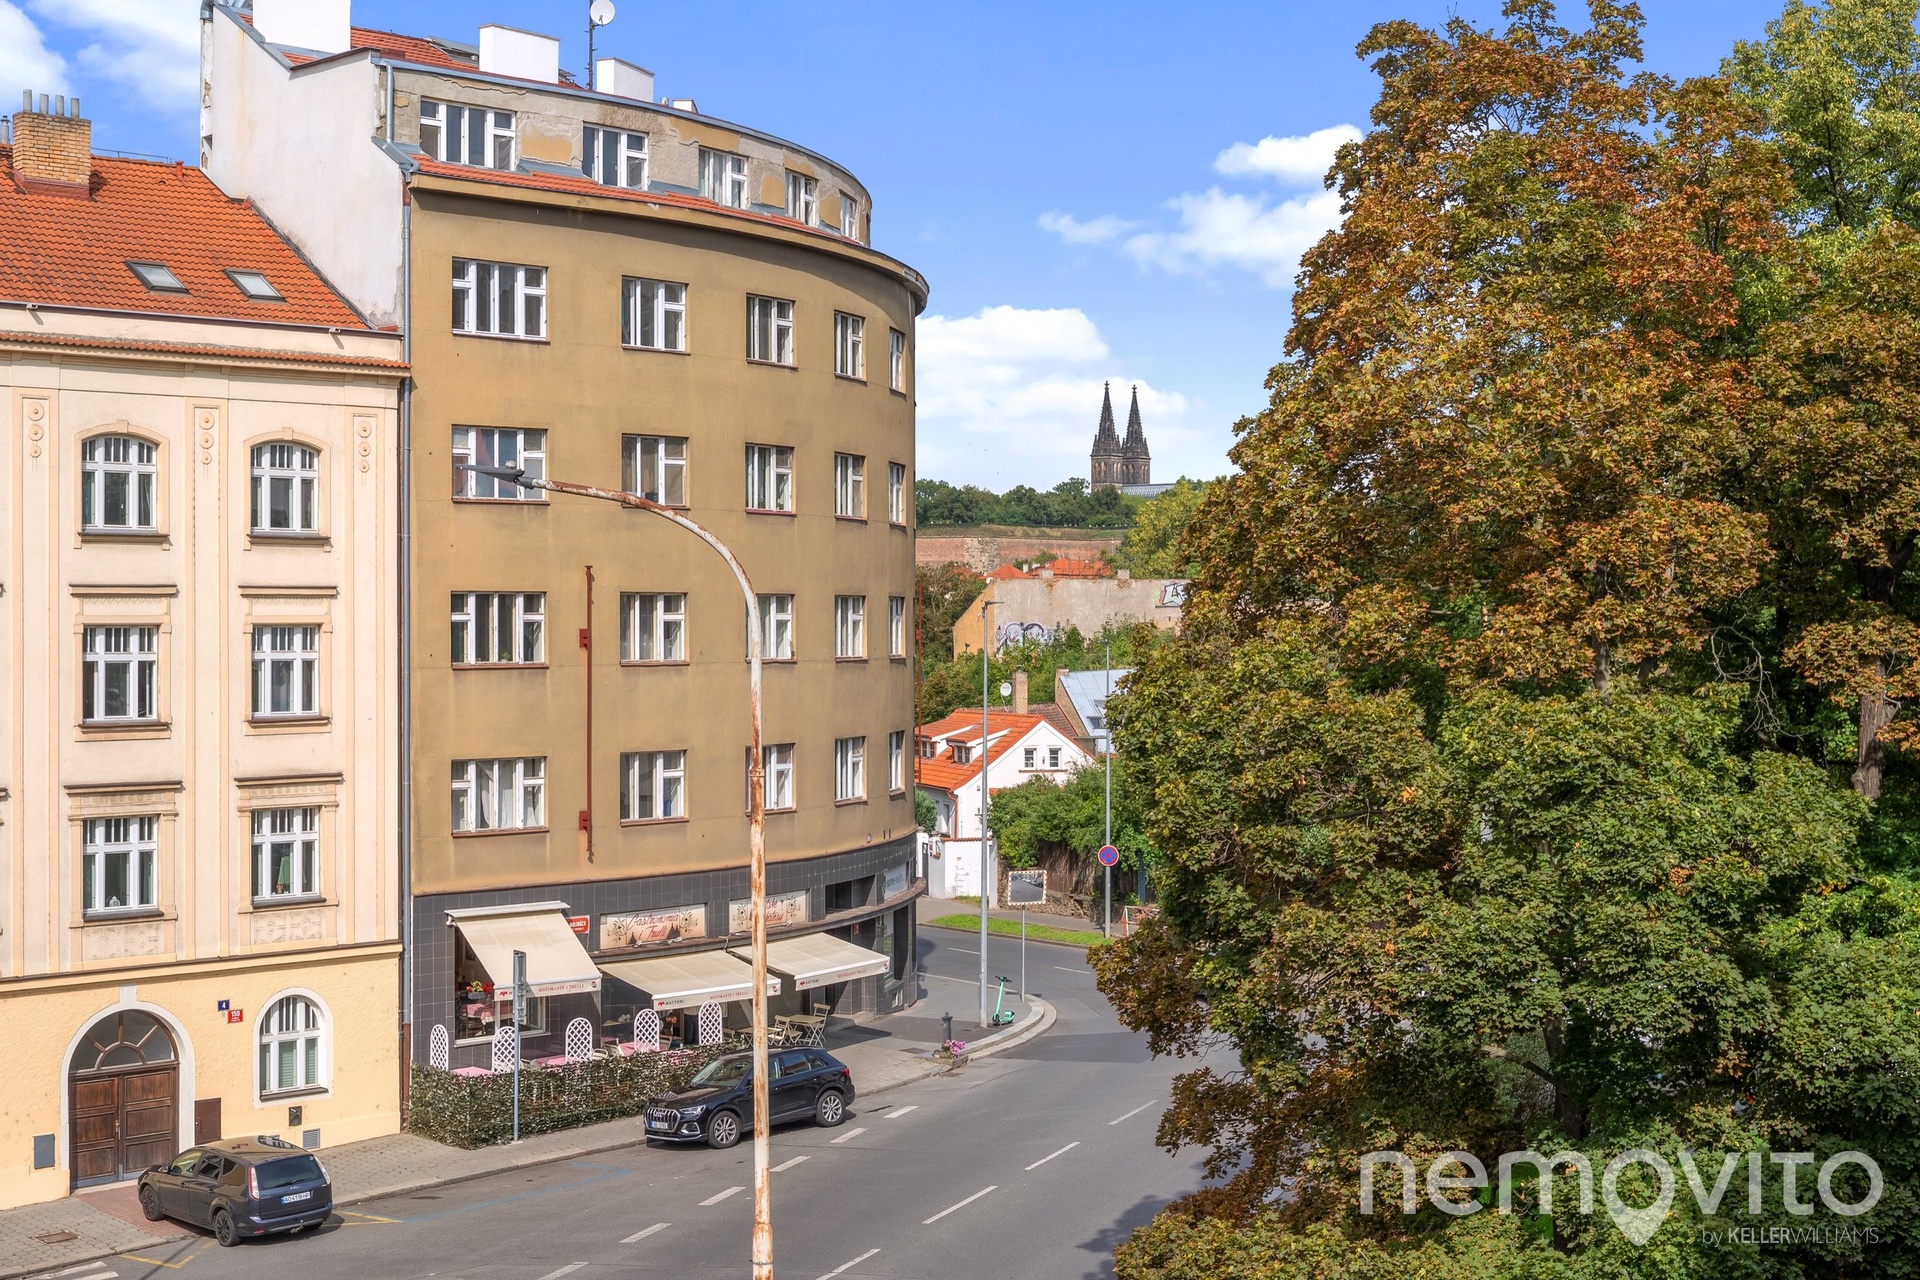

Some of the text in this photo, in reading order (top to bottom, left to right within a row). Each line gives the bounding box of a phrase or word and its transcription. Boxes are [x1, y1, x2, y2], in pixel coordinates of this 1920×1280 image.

[627, 912, 680, 931] Gastronomia
[645, 925, 668, 940] Trulli
[538, 984, 565, 993] RISTORANTE
[221, 1001, 227, 1009] 4
